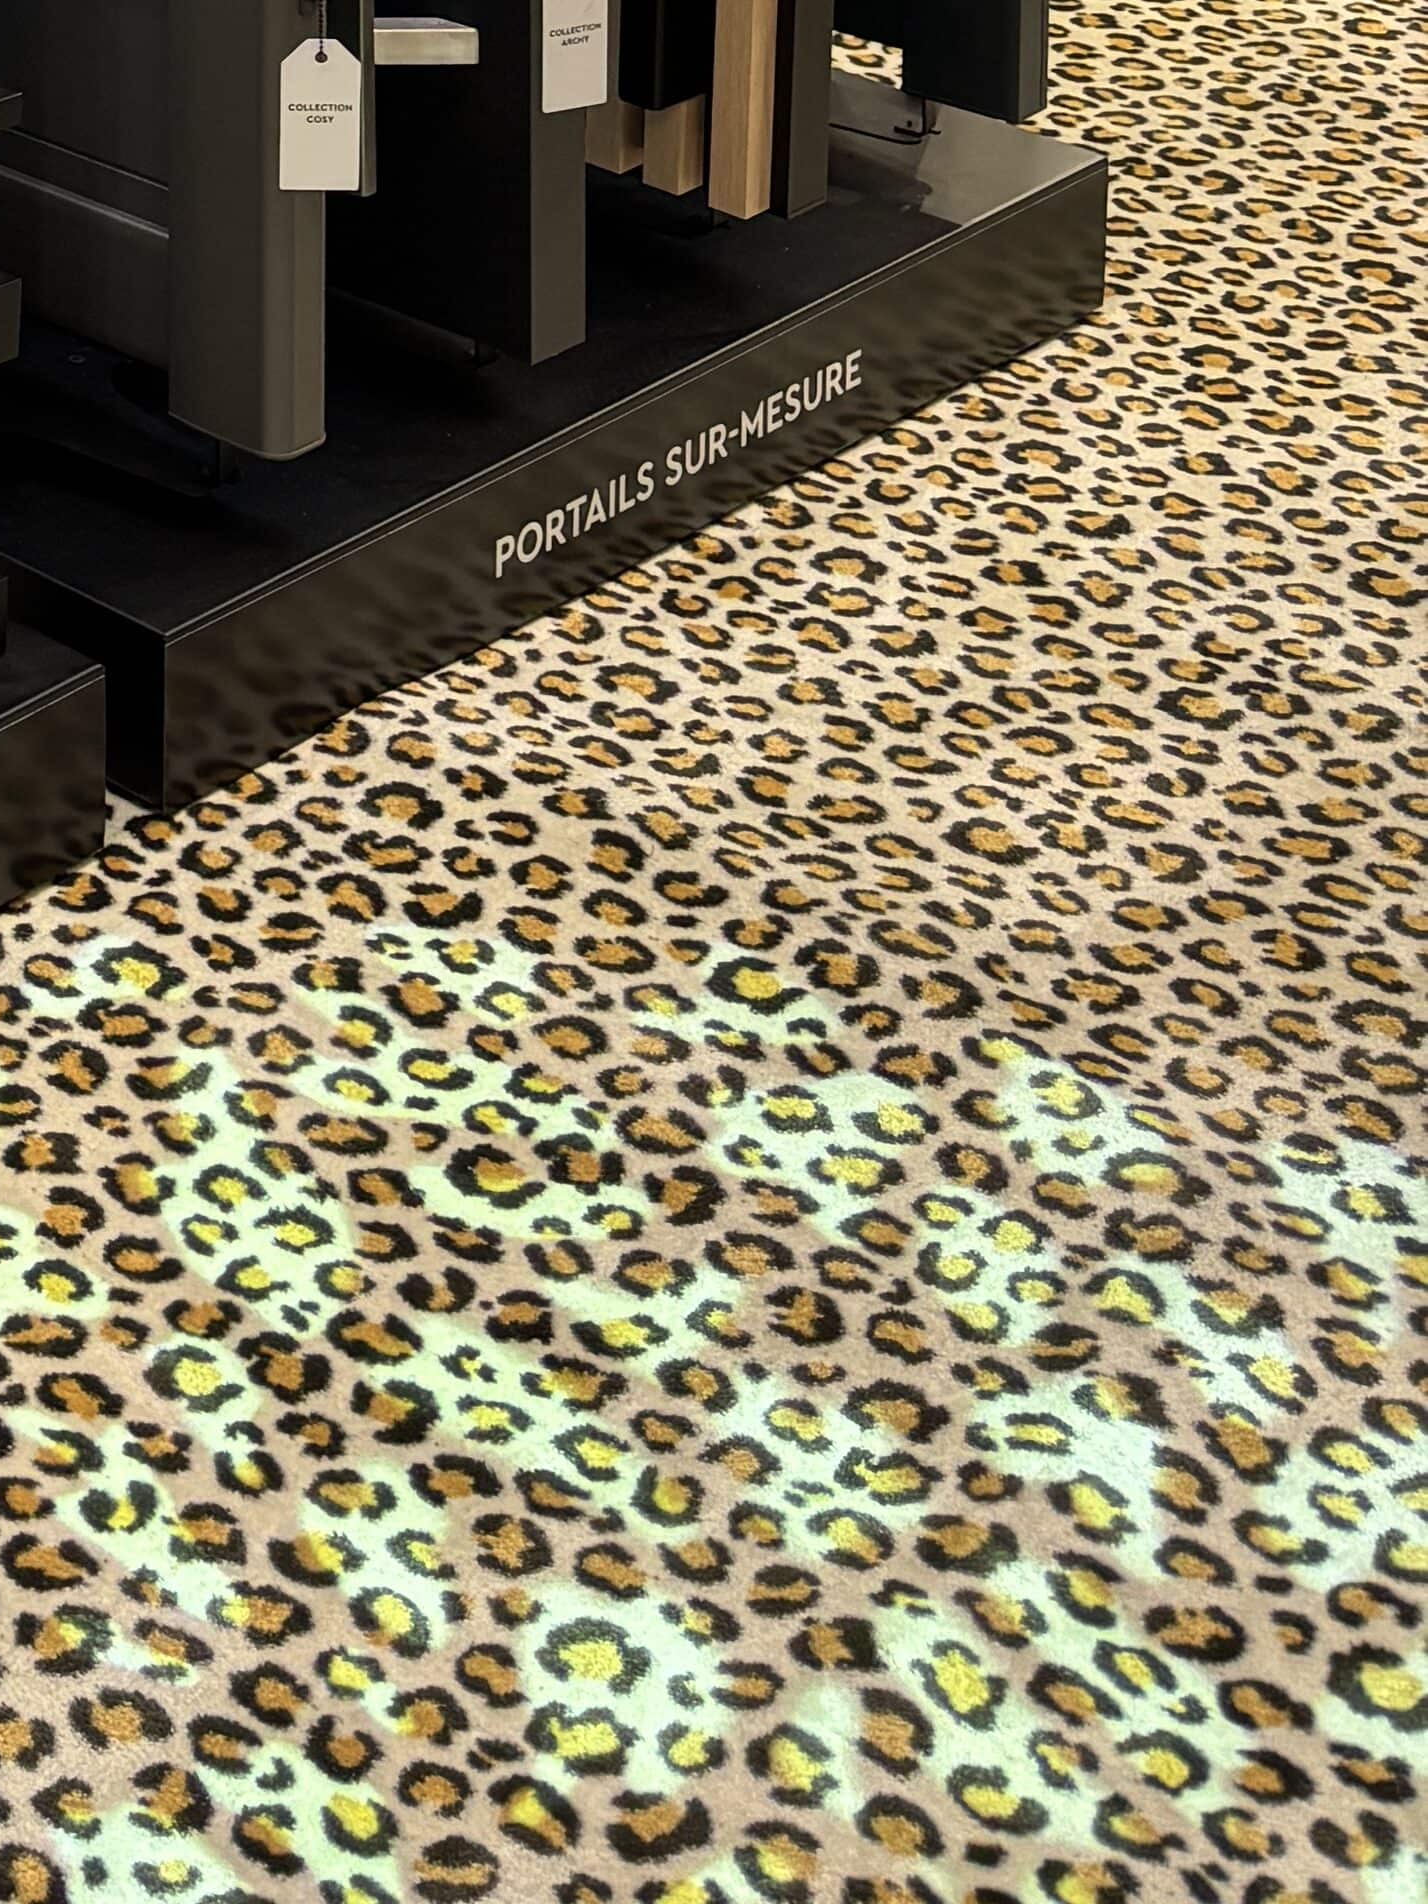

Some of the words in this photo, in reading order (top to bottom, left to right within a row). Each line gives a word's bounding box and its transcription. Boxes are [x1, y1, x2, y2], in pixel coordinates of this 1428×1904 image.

[549, 22, 602, 39] COLLECTION
[288, 103, 353, 113] COLLECTION
[306, 114, 335, 124] COSY
[494, 461, 655, 578] PORTAILS
[664, 348, 863, 488] SUR-MESURE
